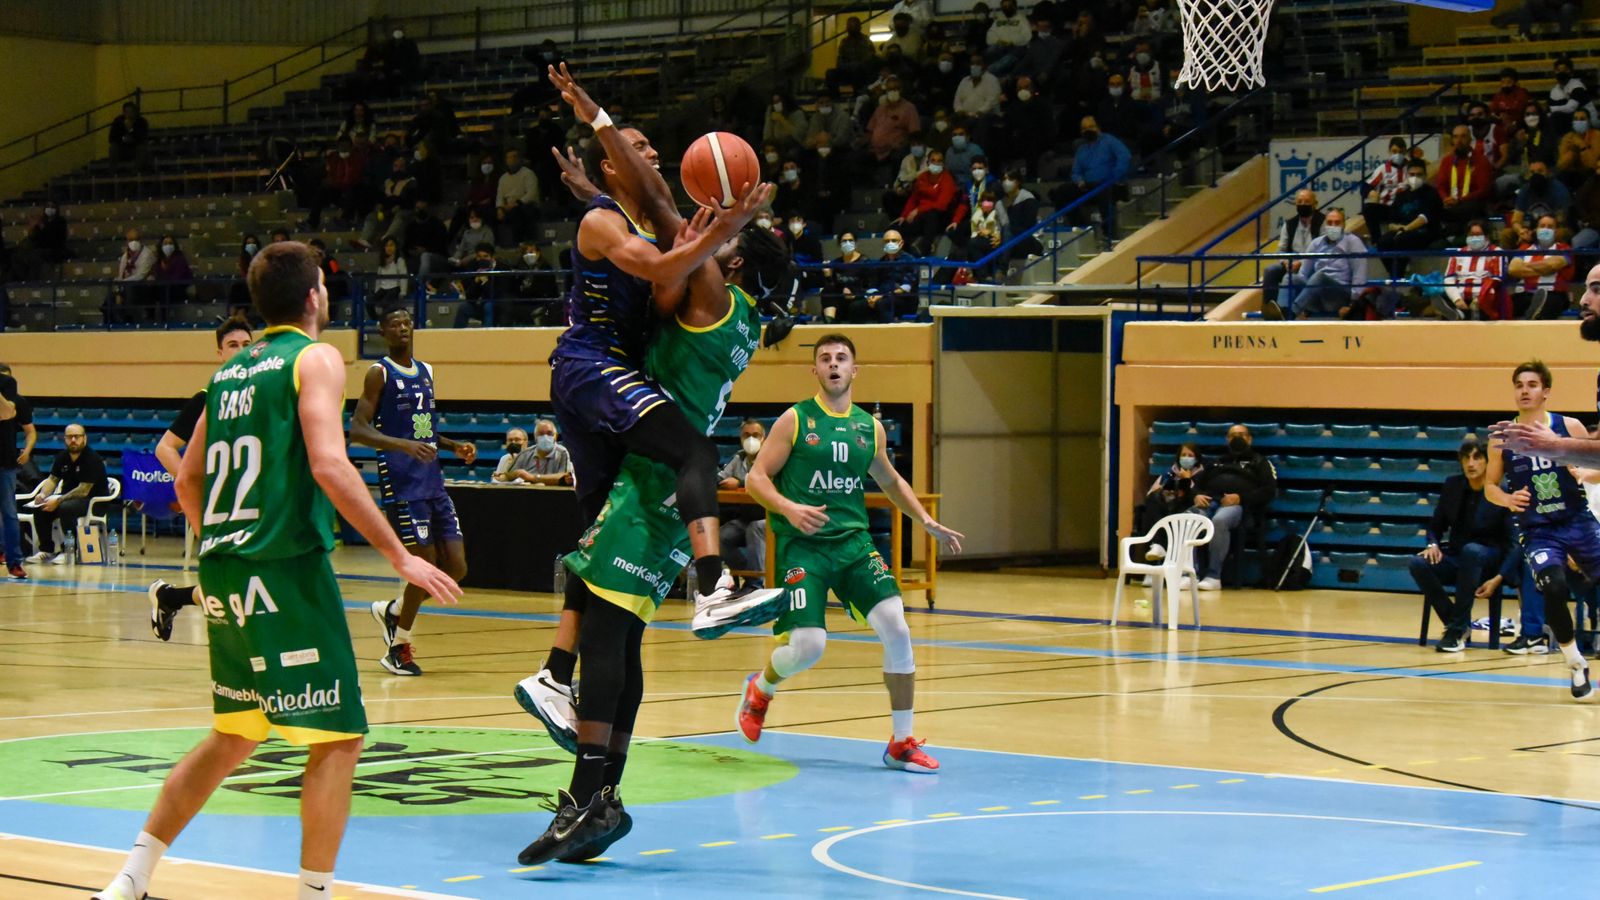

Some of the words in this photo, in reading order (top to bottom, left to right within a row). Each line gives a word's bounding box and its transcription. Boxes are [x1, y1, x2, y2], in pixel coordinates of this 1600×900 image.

[1213, 335, 1278, 349] PRENSA
[1343, 335, 1364, 350] TV
[415, 392, 424, 410] 7
[831, 441, 849, 463] 10
[203, 435, 262, 526] 22
[790, 588, 807, 612] 10
[259, 679, 341, 714] ociedad
